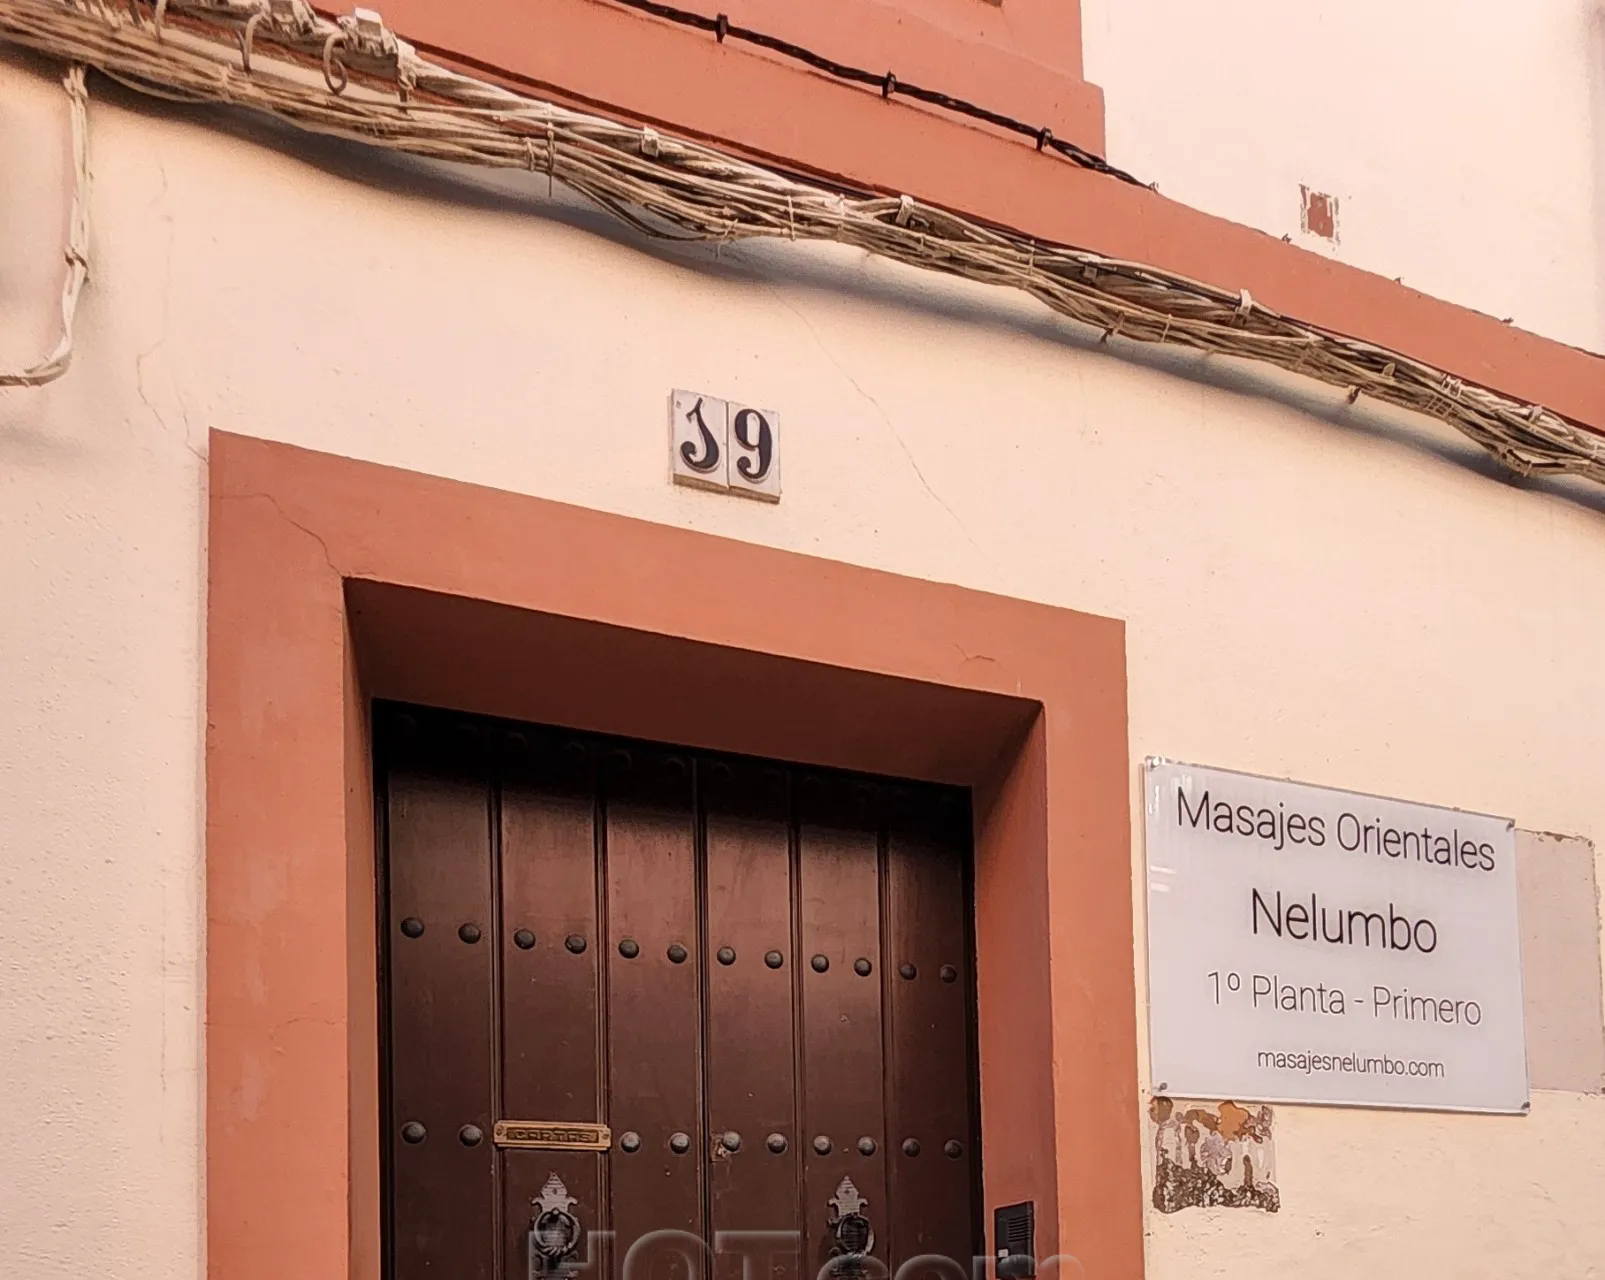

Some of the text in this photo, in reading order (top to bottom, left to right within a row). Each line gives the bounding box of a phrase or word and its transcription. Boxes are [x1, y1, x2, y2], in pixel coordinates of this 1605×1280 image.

[1176, 786, 1496, 872] Masajes Orientales
[1251, 888, 1438, 953] Nelumbo
[1252, 974, 1346, 1015] Planta
[1373, 986, 1482, 1026] Primero
[1257, 1050, 1445, 1078] masajesnelumbo.com
